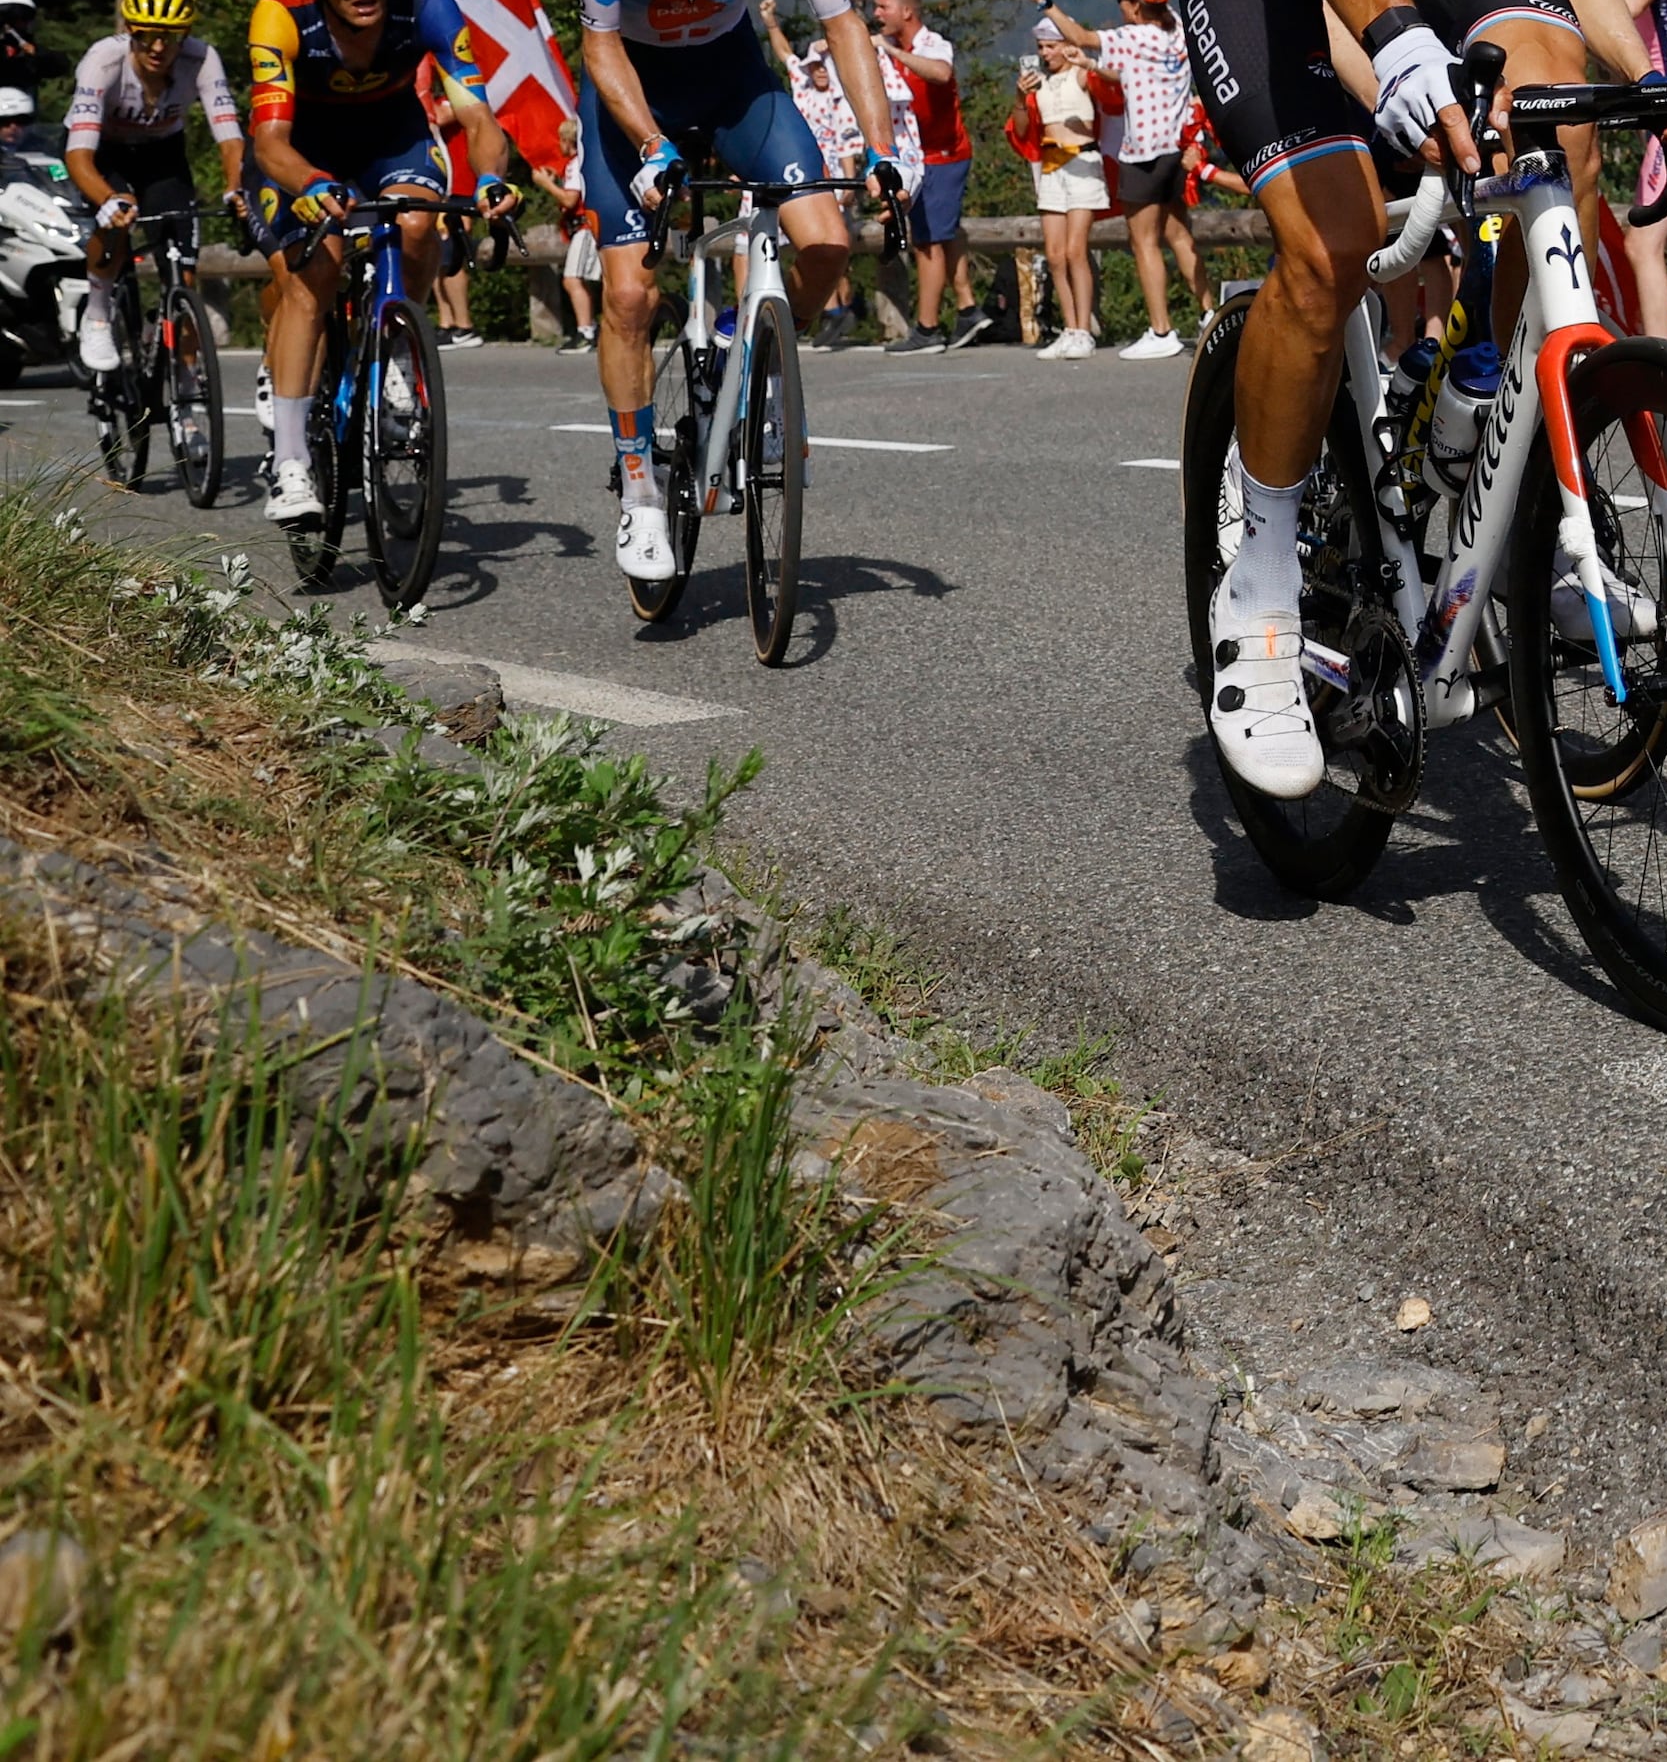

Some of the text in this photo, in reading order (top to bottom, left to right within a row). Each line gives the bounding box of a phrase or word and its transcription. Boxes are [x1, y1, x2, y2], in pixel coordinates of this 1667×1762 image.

[1512, 97, 1577, 111] Wilier
[1205, 310, 1245, 356] RESERV
[1449, 320, 1528, 563] Wilier
